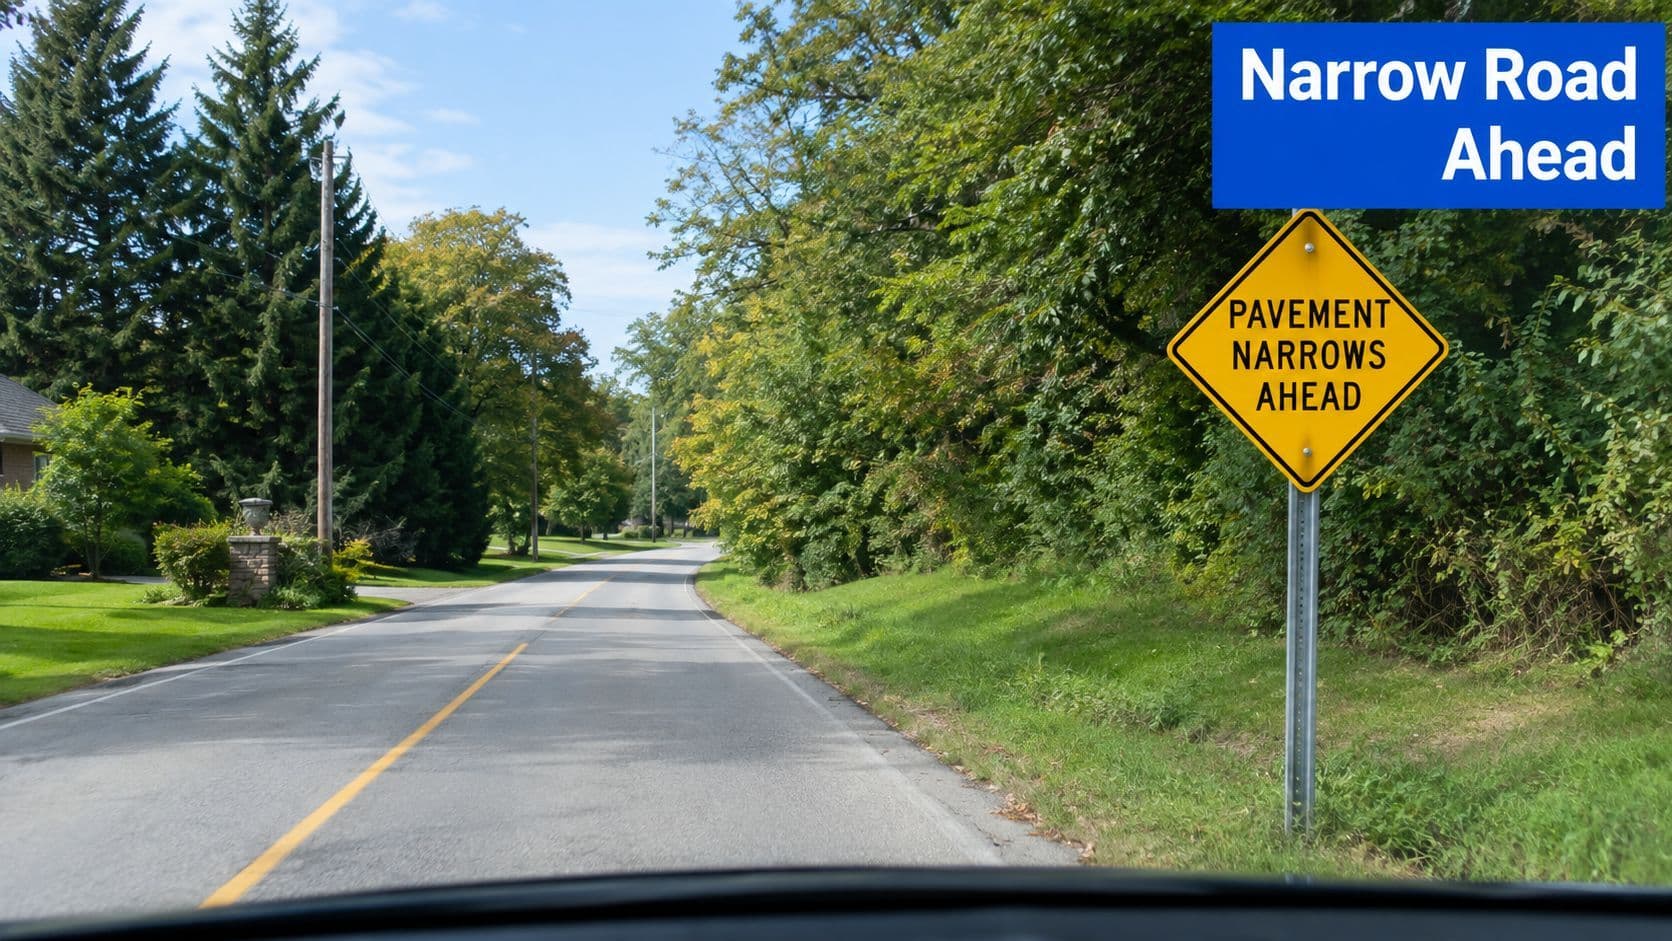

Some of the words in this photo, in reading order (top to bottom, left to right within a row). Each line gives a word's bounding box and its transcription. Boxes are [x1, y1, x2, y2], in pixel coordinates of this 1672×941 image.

[1229, 299, 1391, 329] PAVEMENT
[1233, 340, 1385, 369] NARROWS
[1256, 382, 1360, 410] AHEAD
